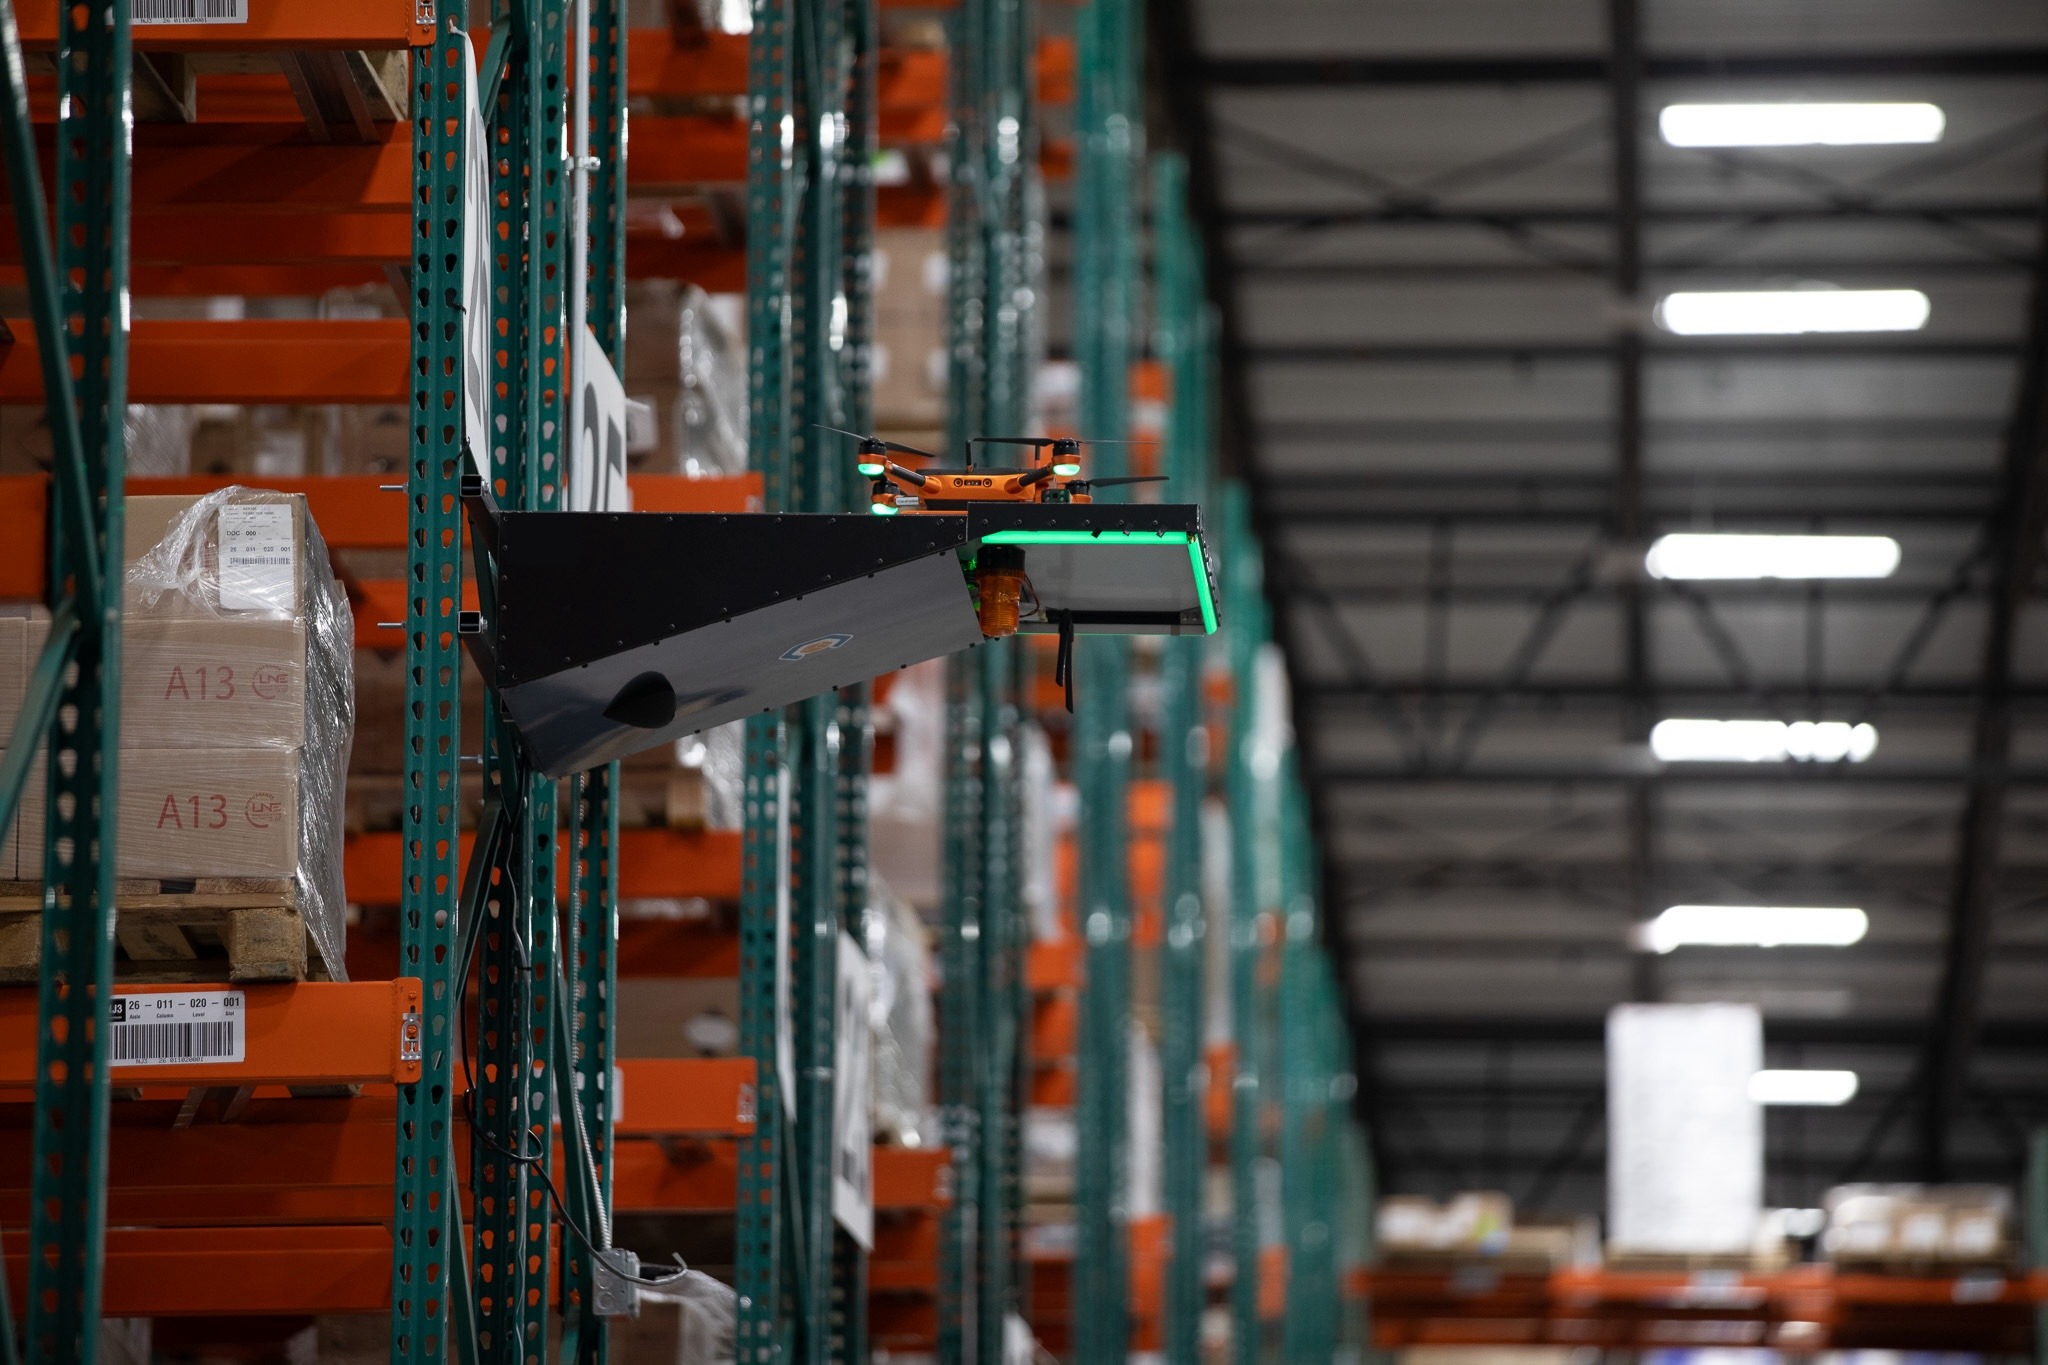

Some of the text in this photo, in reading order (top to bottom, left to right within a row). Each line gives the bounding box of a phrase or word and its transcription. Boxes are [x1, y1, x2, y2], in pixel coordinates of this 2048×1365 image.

[467, 107, 489, 459] 26
[164, 665, 235, 700] A13
[157, 794, 228, 829] A13
[128, 1000, 140, 1010] 26
[156, 999, 173, 1009] 011
[190, 998, 207, 1008] 020
[223, 997, 240, 1007] 001
